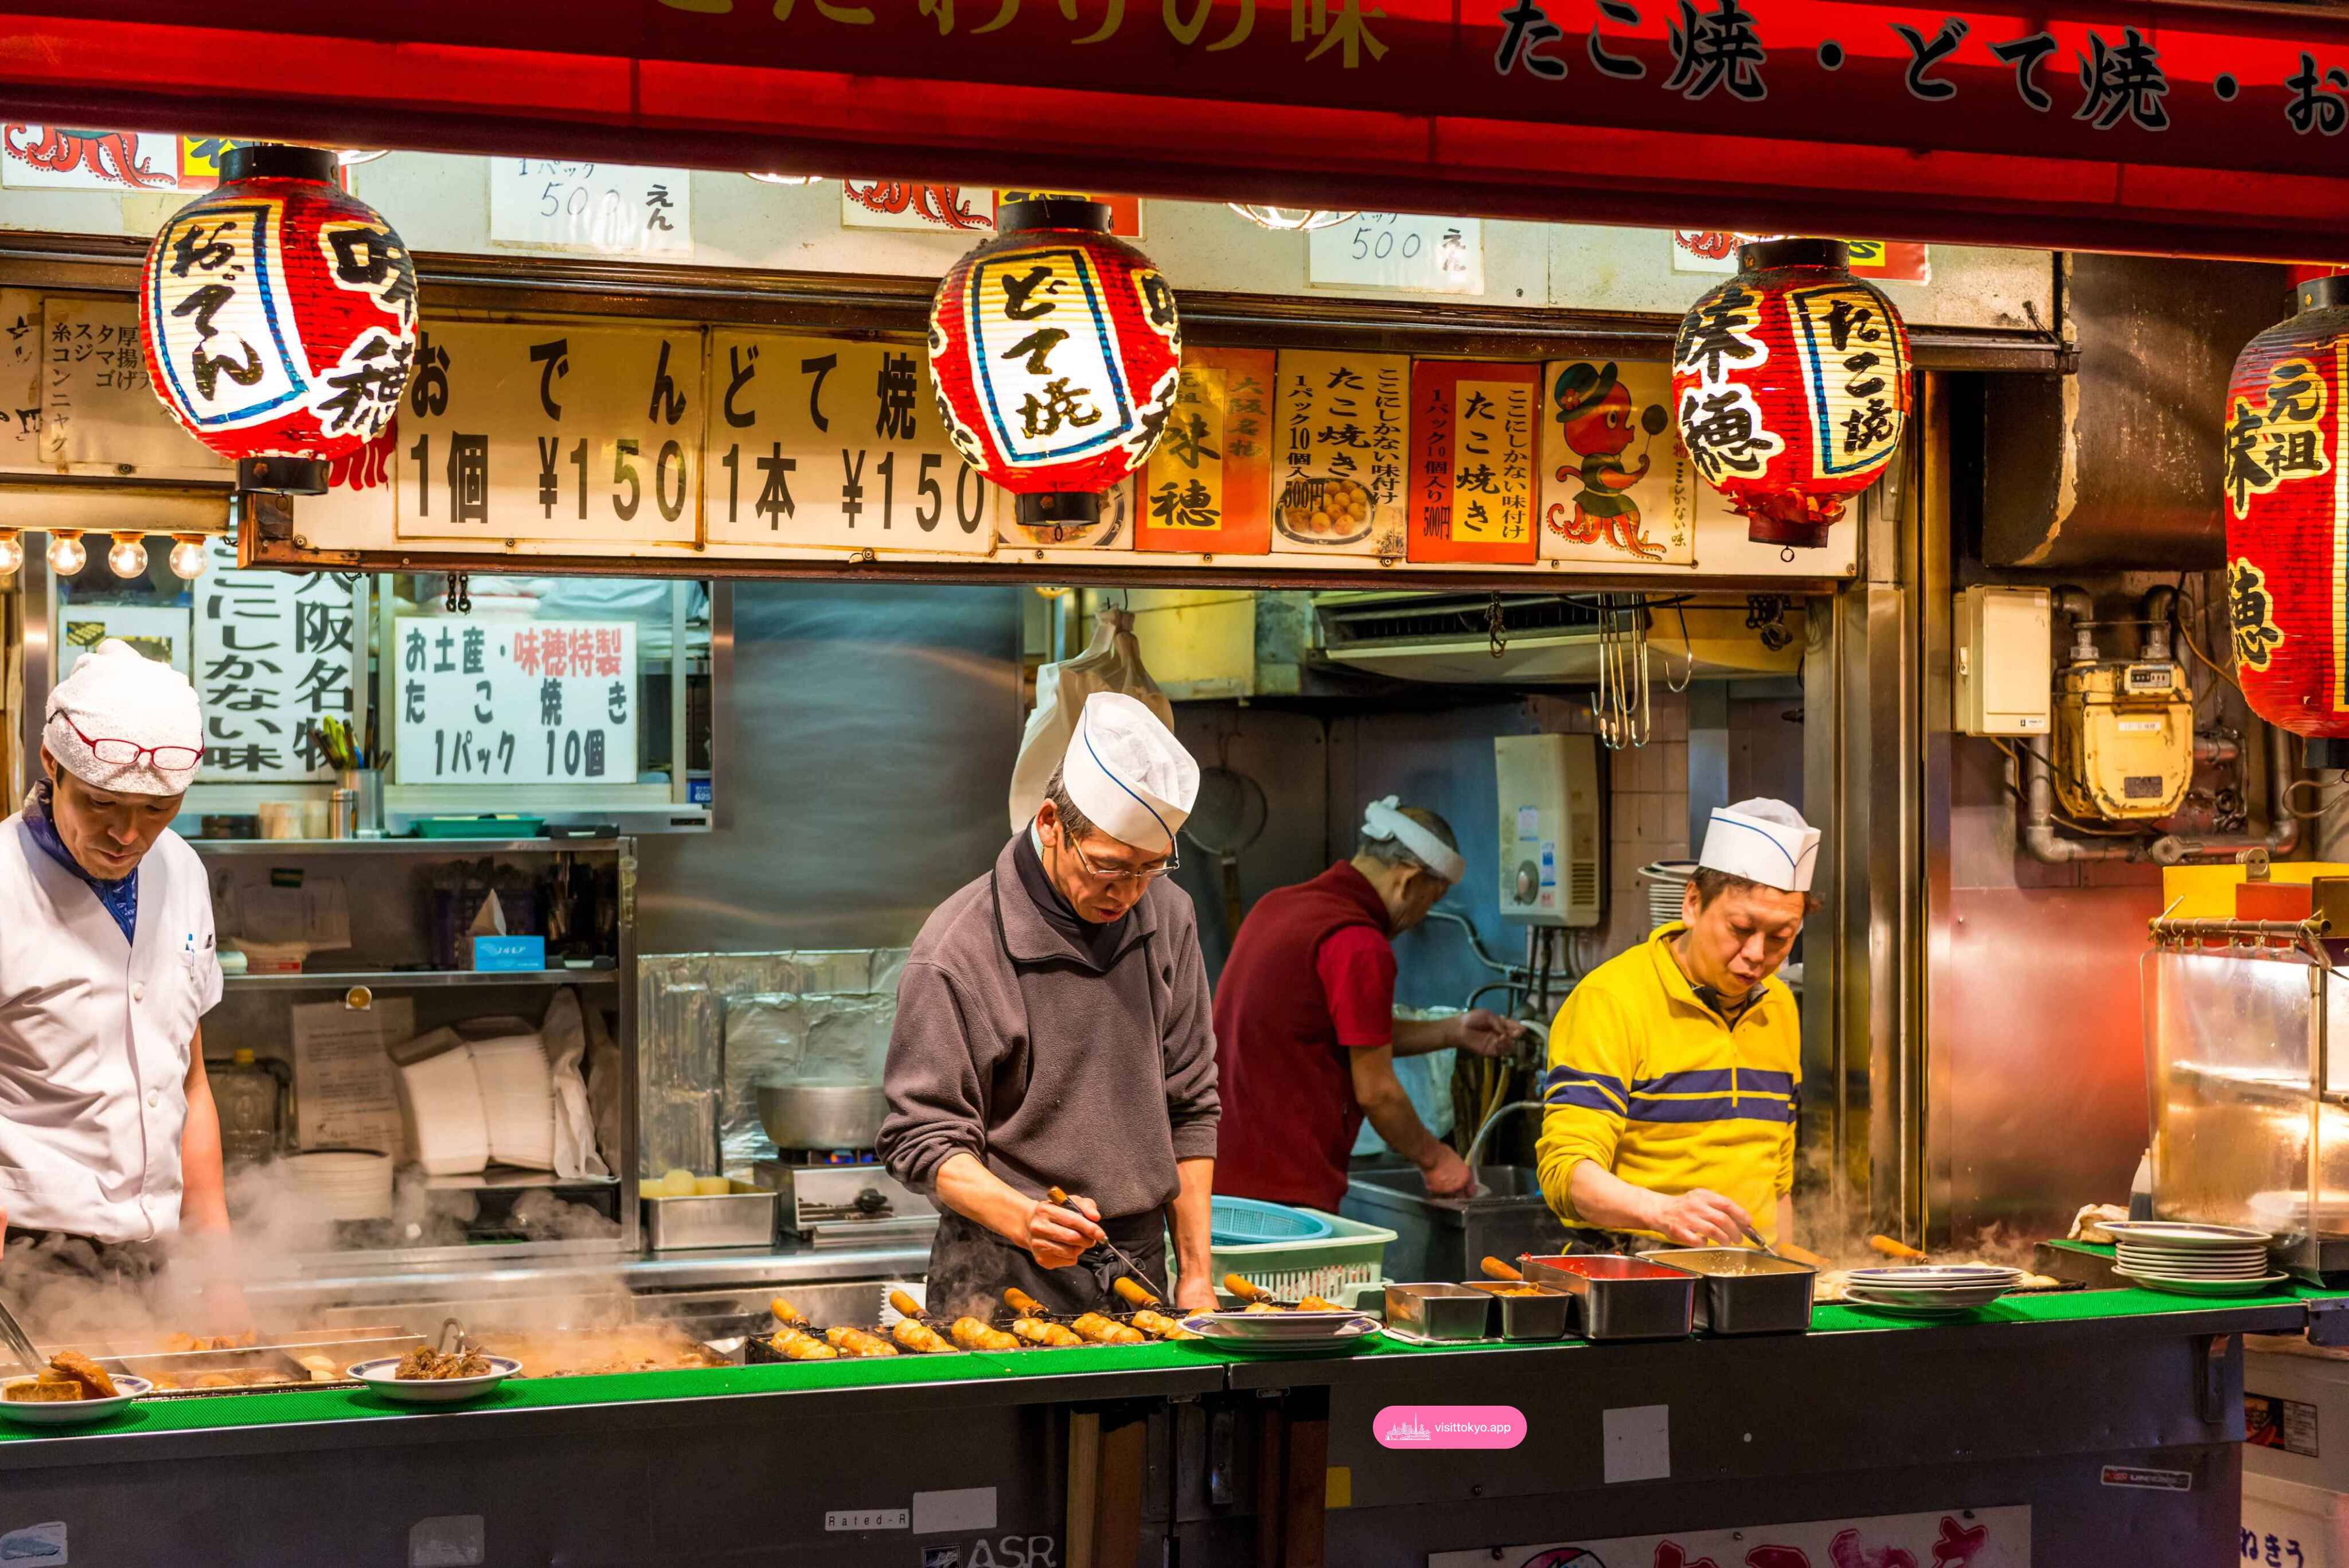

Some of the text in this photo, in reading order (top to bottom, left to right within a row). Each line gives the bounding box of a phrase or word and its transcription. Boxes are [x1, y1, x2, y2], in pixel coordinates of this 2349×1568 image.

[645, 184, 674, 231] えん
[1352, 227, 1421, 260] 500
[74, 323, 93, 362] スジ
[96, 324, 115, 388] タマゴ
[117, 326, 139, 391] 厚揚げ
[171, 222, 263, 401] おでん
[1001, 266, 1102, 439] どて焼
[50, 322, 72, 453] 糸コンニャク
[411, 331, 688, 426] おでん
[724, 345, 917, 440] どて焼
[1317, 366, 1371, 477] たこ焼き
[1820, 299, 1893, 455] たこ焼
[2265, 363, 2323, 477] 元祖
[411, 430, 688, 524] 1個 ¥150
[1150, 412, 1222, 528] 味穂
[1371, 368, 1401, 505] ここにしかない味付け
[1456, 391, 1501, 532] たこ焼き
[1502, 389, 1528, 539] ここにしかない味付け
[722, 442, 985, 534] 1本 ¥150
[405, 677, 627, 726] たこ焼き
[547, 729, 605, 777] 10個
[829, 1513, 907, 1528] Rated-R
